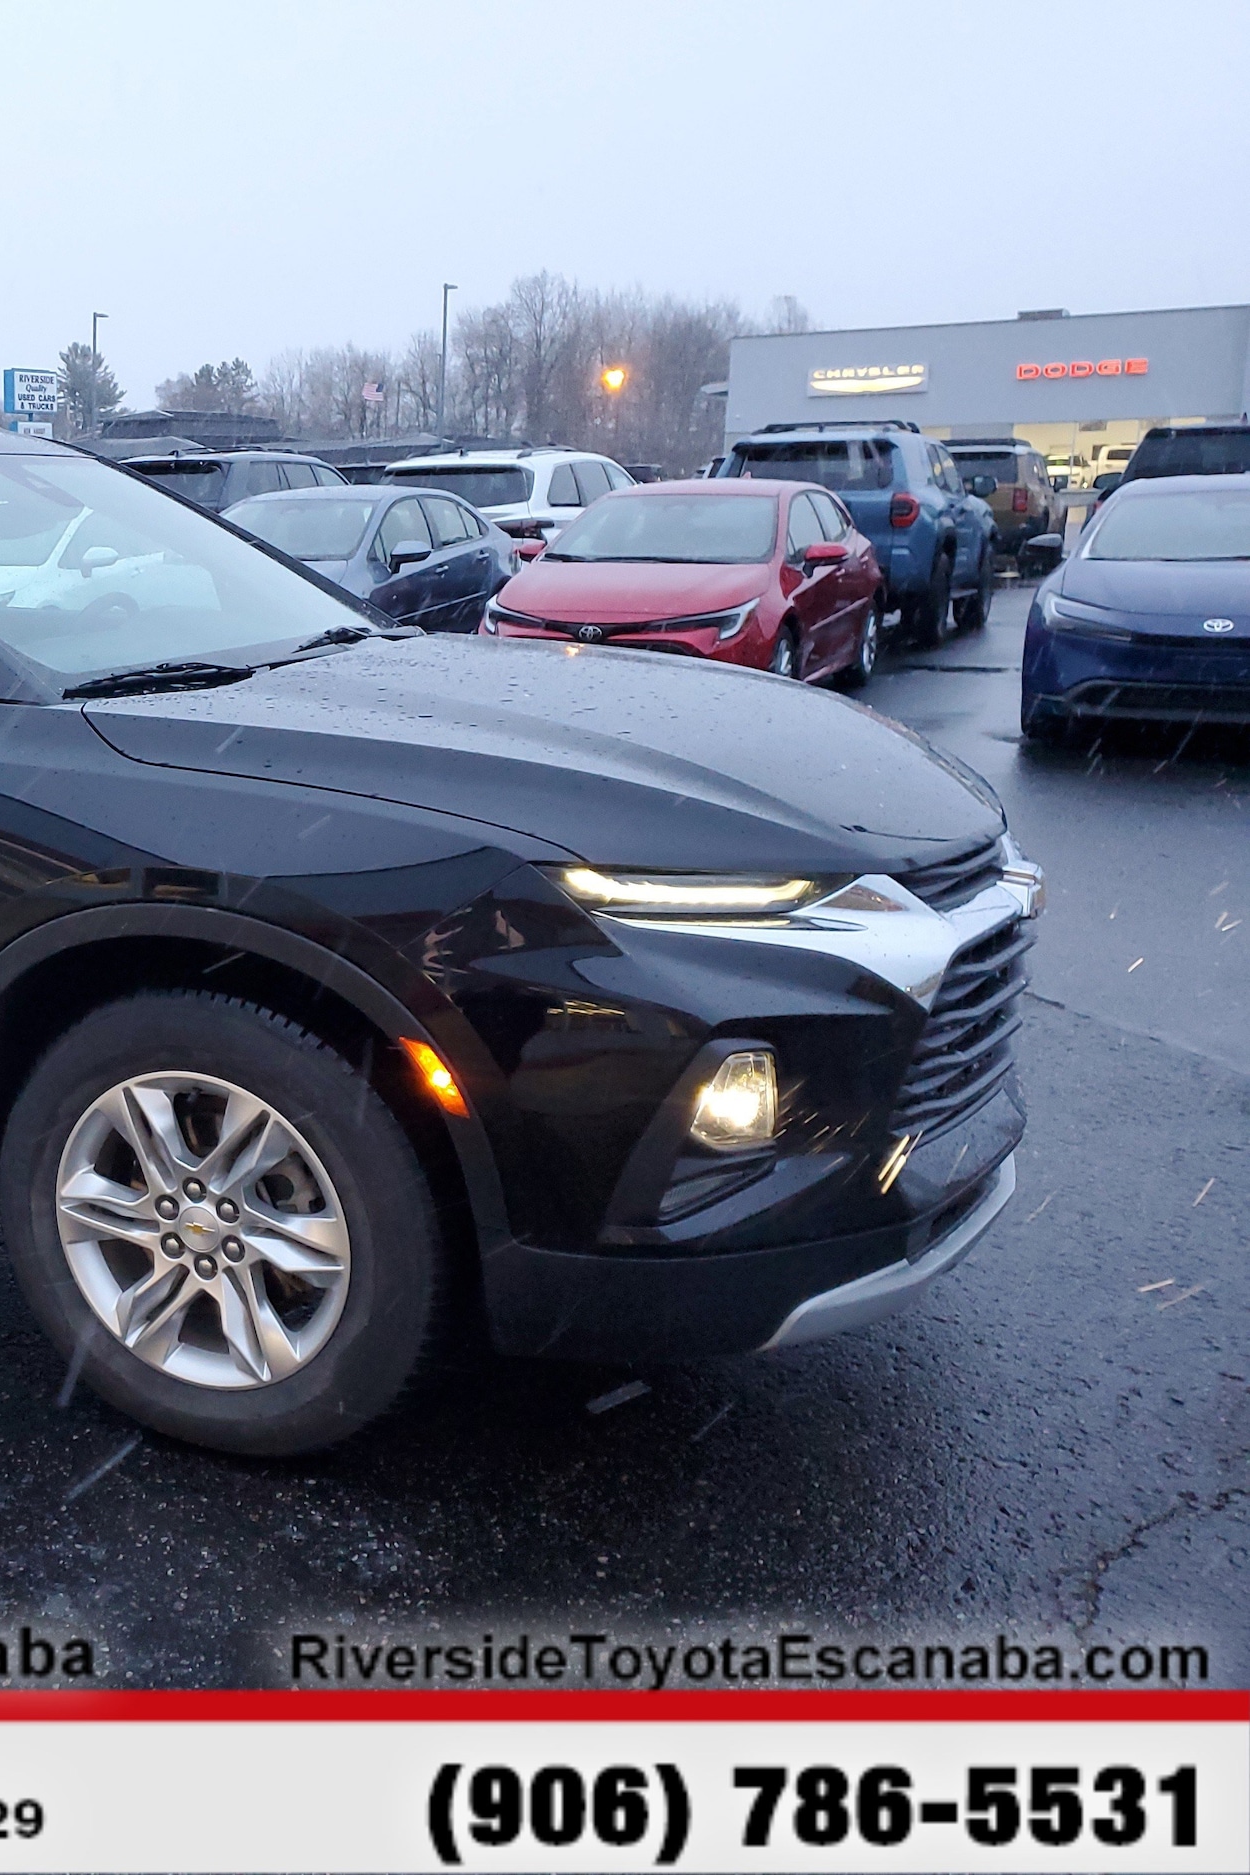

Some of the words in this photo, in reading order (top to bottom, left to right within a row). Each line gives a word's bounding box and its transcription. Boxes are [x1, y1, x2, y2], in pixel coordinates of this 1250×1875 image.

[813, 364, 925, 379] CHRYSLER
[1016, 358, 1149, 380] DODGE
[19, 374, 54, 384] RIVERSIDE
[25, 384, 47, 392] Quality
[18, 393, 35, 401] USED
[38, 394, 56, 402] CARS
[28, 402, 54, 410] TRUCKS
